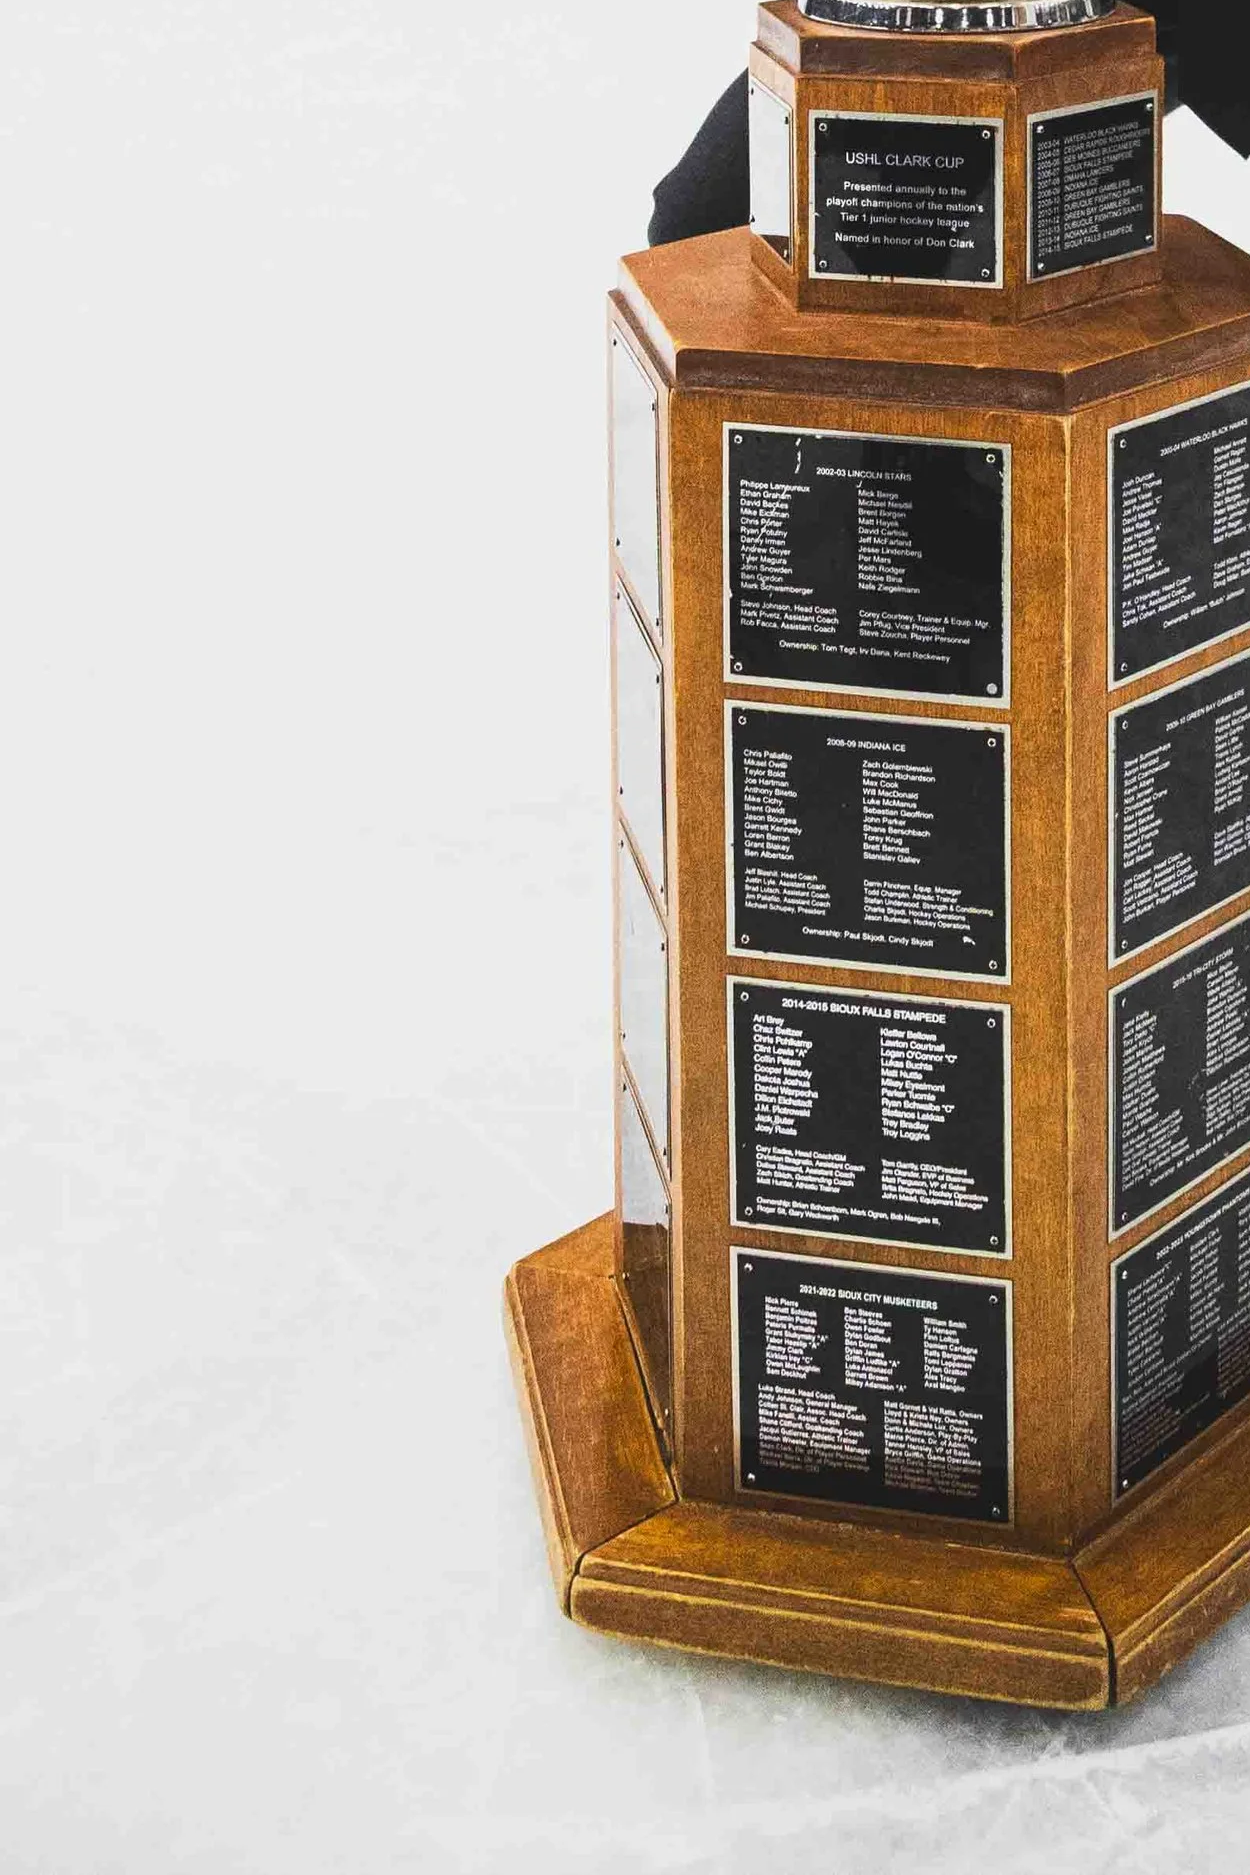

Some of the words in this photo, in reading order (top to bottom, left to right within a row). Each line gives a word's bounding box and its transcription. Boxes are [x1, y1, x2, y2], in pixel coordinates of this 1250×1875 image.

[845, 152, 880, 165] USHL
[885, 154, 930, 167] CLARK
[935, 156, 963, 169] CUP
[843, 181, 891, 192] Presented
[895, 184, 934, 196] annually
[938, 186, 947, 194] to
[951, 186, 965, 195] the
[826, 196, 857, 208] playoff
[861, 198, 911, 211] champions
[916, 201, 923, 209] of
[928, 201, 942, 210] the
[946, 202, 983, 212] nation's
[840, 212, 858, 221] Tier
[862, 213, 865, 222] 1
[870, 214, 896, 226] junior
[900, 215, 933, 228] hockey
[937, 217, 969, 229] league
[835, 233, 868, 243] Named
[872, 235, 880, 243] in
[884, 235, 910, 245] honor
[914, 237, 922, 245] of
[926, 238, 945, 247] Don
[949, 239, 974, 248] Clark
[816, 467, 846, 476] 2002-03
[847, 469, 882, 479] LINCOLN
[885, 472, 911, 481] STARS
[793, 604, 813, 612] Head
[814, 606, 837, 614] Coach
[780, 622, 811, 631] Assistant
[813, 624, 835, 633] Coach
[894, 622, 910, 630] Vice
[911, 623, 944, 633] President
[857, 740, 891, 751] INDIANA
[892, 743, 905, 752] ICE
[781, 998, 828, 1011] 2014-2015
[829, 1003, 860, 1014] SIOUX
[862, 1006, 891, 1018] FALLS
[893, 1009, 946, 1023] STAMPEDE
[837, 1289, 861, 1300] SIOUX
[863, 1293, 881, 1302] CITY
[882, 1295, 937, 1309] MUSKETEERS
